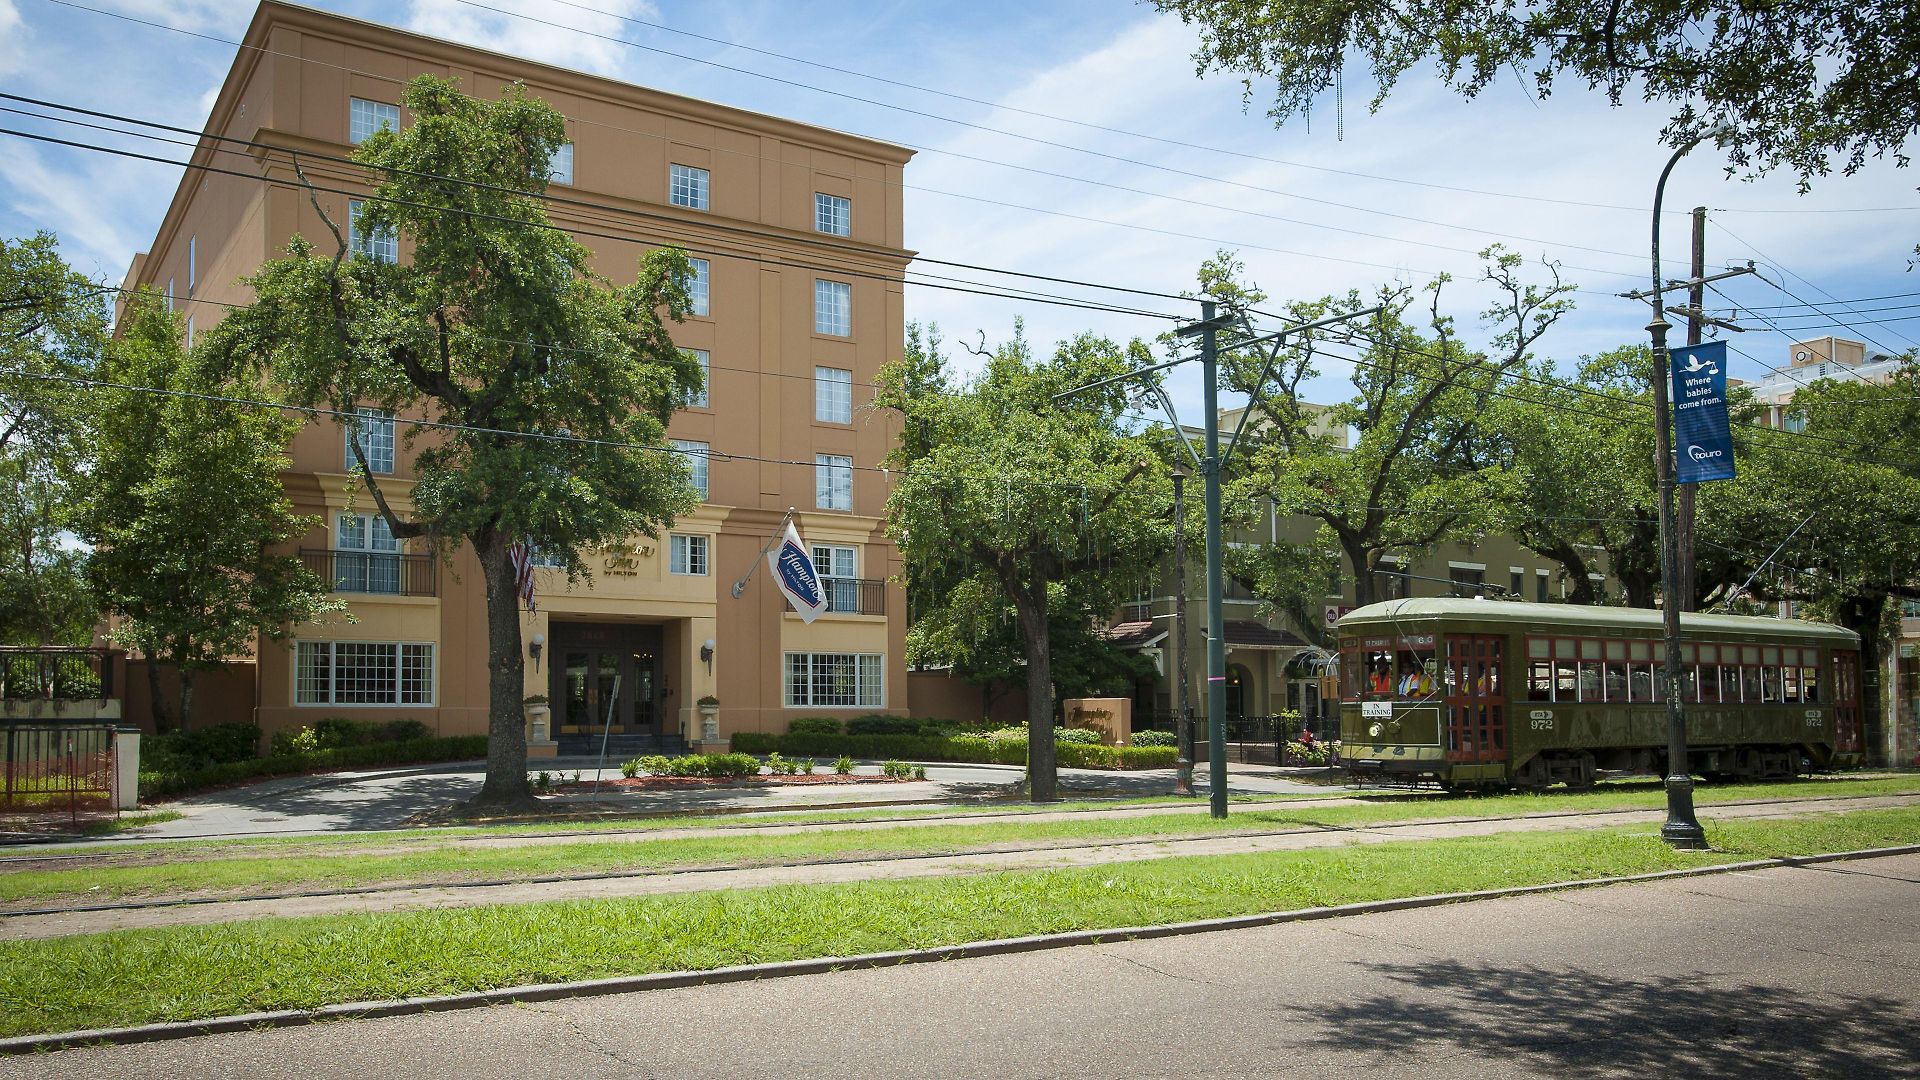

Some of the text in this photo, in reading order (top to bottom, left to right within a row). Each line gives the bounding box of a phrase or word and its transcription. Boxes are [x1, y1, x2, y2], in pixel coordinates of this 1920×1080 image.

[1685, 376, 1712, 387] Where
[1686, 387, 1712, 398] babies
[1679, 397, 1722, 410] come from.
[1694, 450, 1722, 459] touro
[780, 548, 821, 600] Hampton
[1530, 719, 1553, 730] 972
[1806, 718, 1822, 727] 972
